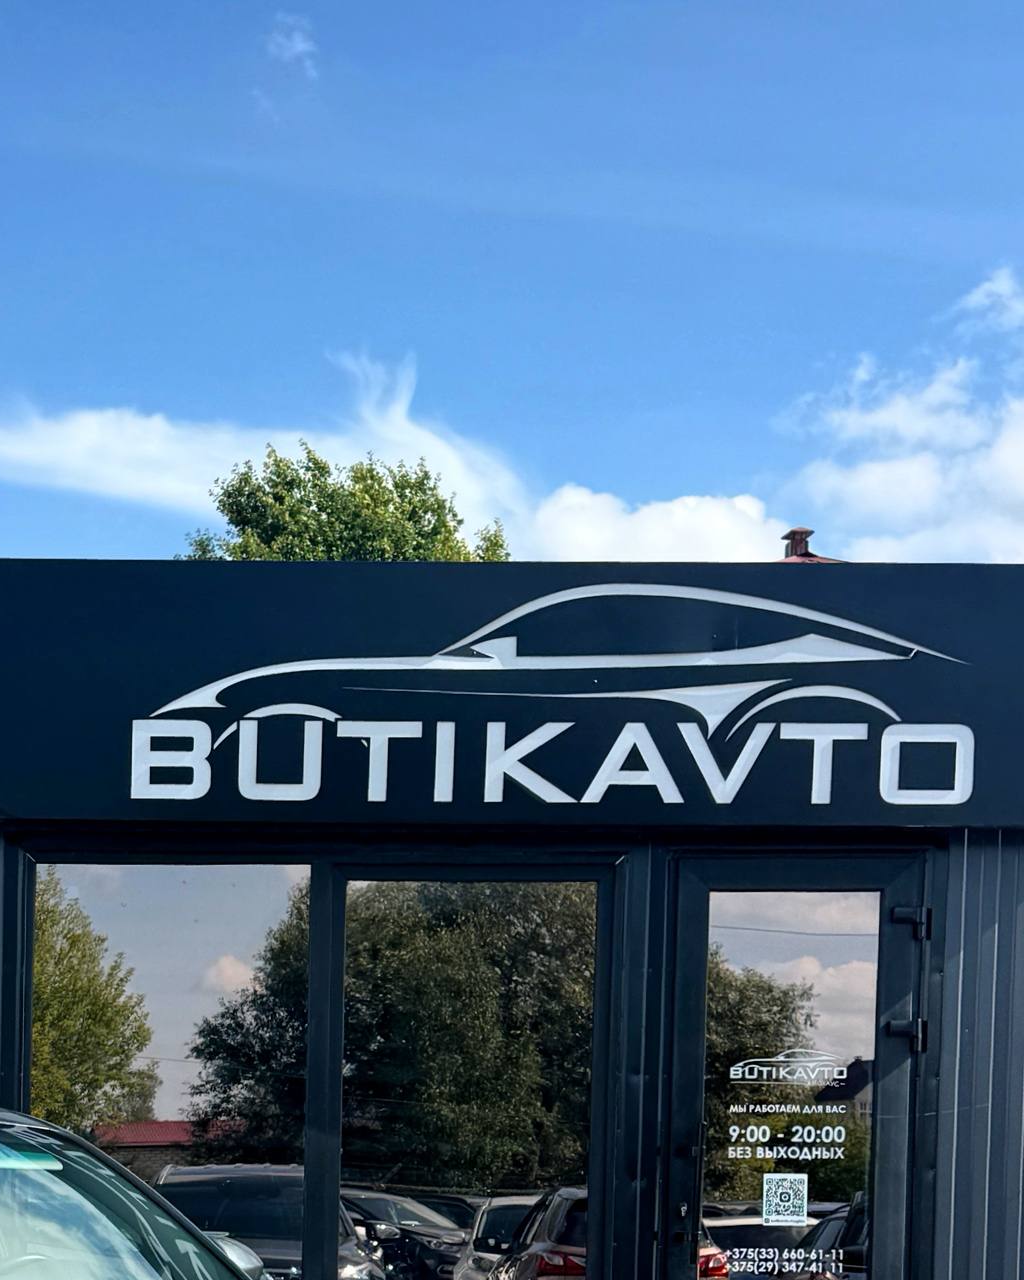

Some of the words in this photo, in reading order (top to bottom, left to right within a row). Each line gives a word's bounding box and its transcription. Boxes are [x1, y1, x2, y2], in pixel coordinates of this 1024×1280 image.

[129, 718, 976, 807] BUTIKAVTO
[729, 1066, 847, 1080] BUTIKAVTO
[729, 1104, 747, 1113] МЫ
[749, 1104, 801, 1113] РАБОТАЕМ
[802, 1105, 823, 1114] ДЛЯ
[825, 1105, 847, 1114] ВАС
[729, 1125, 771, 1143] 9:00
[790, 1125, 846, 1143] 20:00
[727, 1146, 753, 1159] БЕЗ
[756, 1146, 845, 1160] ВЫХОДНЫХ
[724, 1248, 779, 1263] +375(33)
[782, 1248, 844, 1260] 660-61-11
[724, 1261, 779, 1275] +375(29)
[782, 1262, 844, 1273] 347-4111
